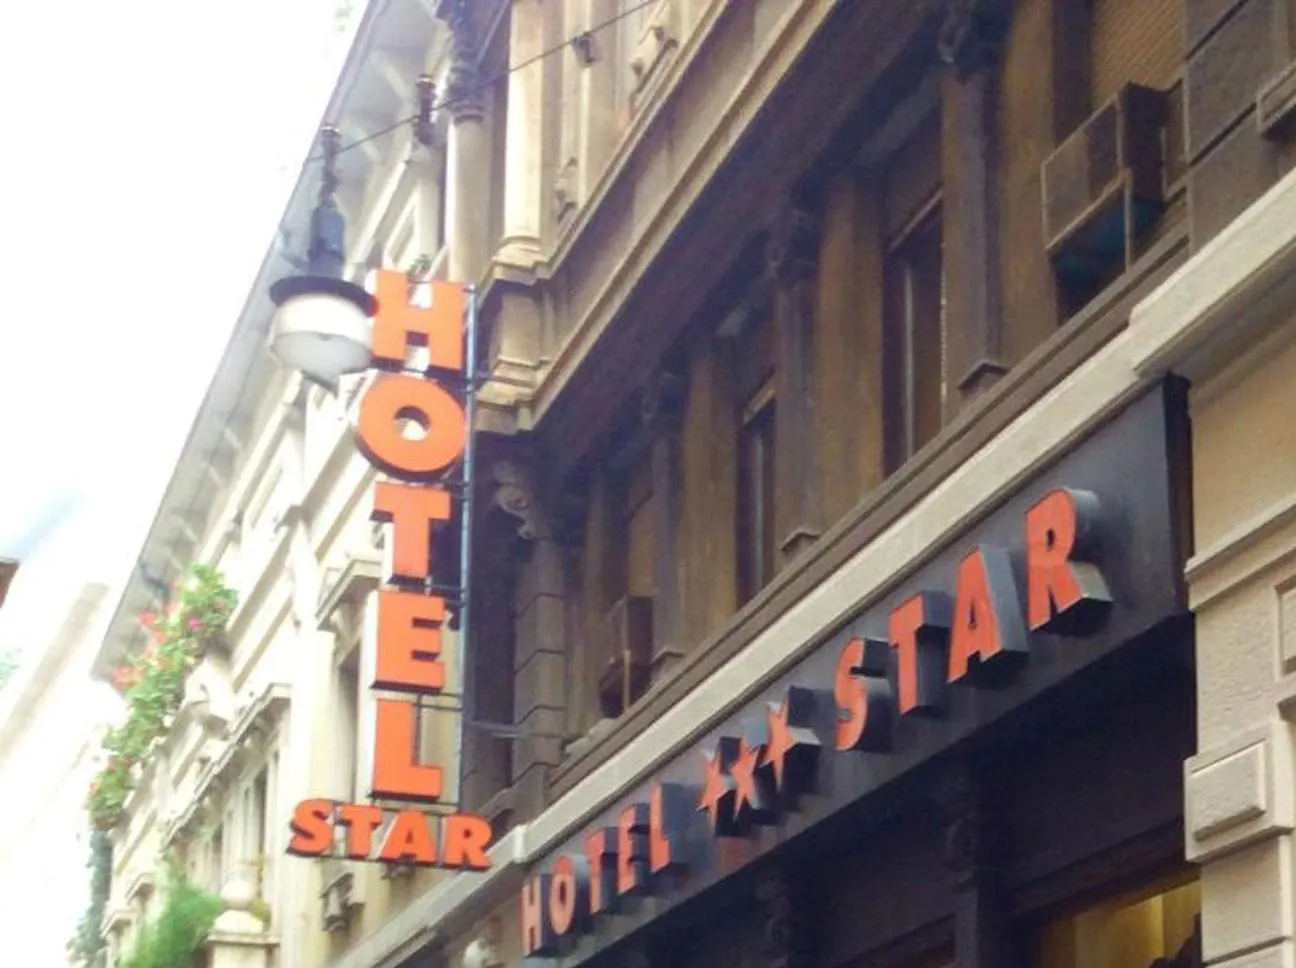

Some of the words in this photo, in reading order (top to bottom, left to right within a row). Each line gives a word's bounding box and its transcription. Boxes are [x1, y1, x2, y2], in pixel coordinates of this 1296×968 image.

[356, 268, 468, 801] HOTEL
[521, 783, 676, 956] HOTEL
[833, 487, 1088, 752] STAR
[287, 797, 493, 869] STAR
